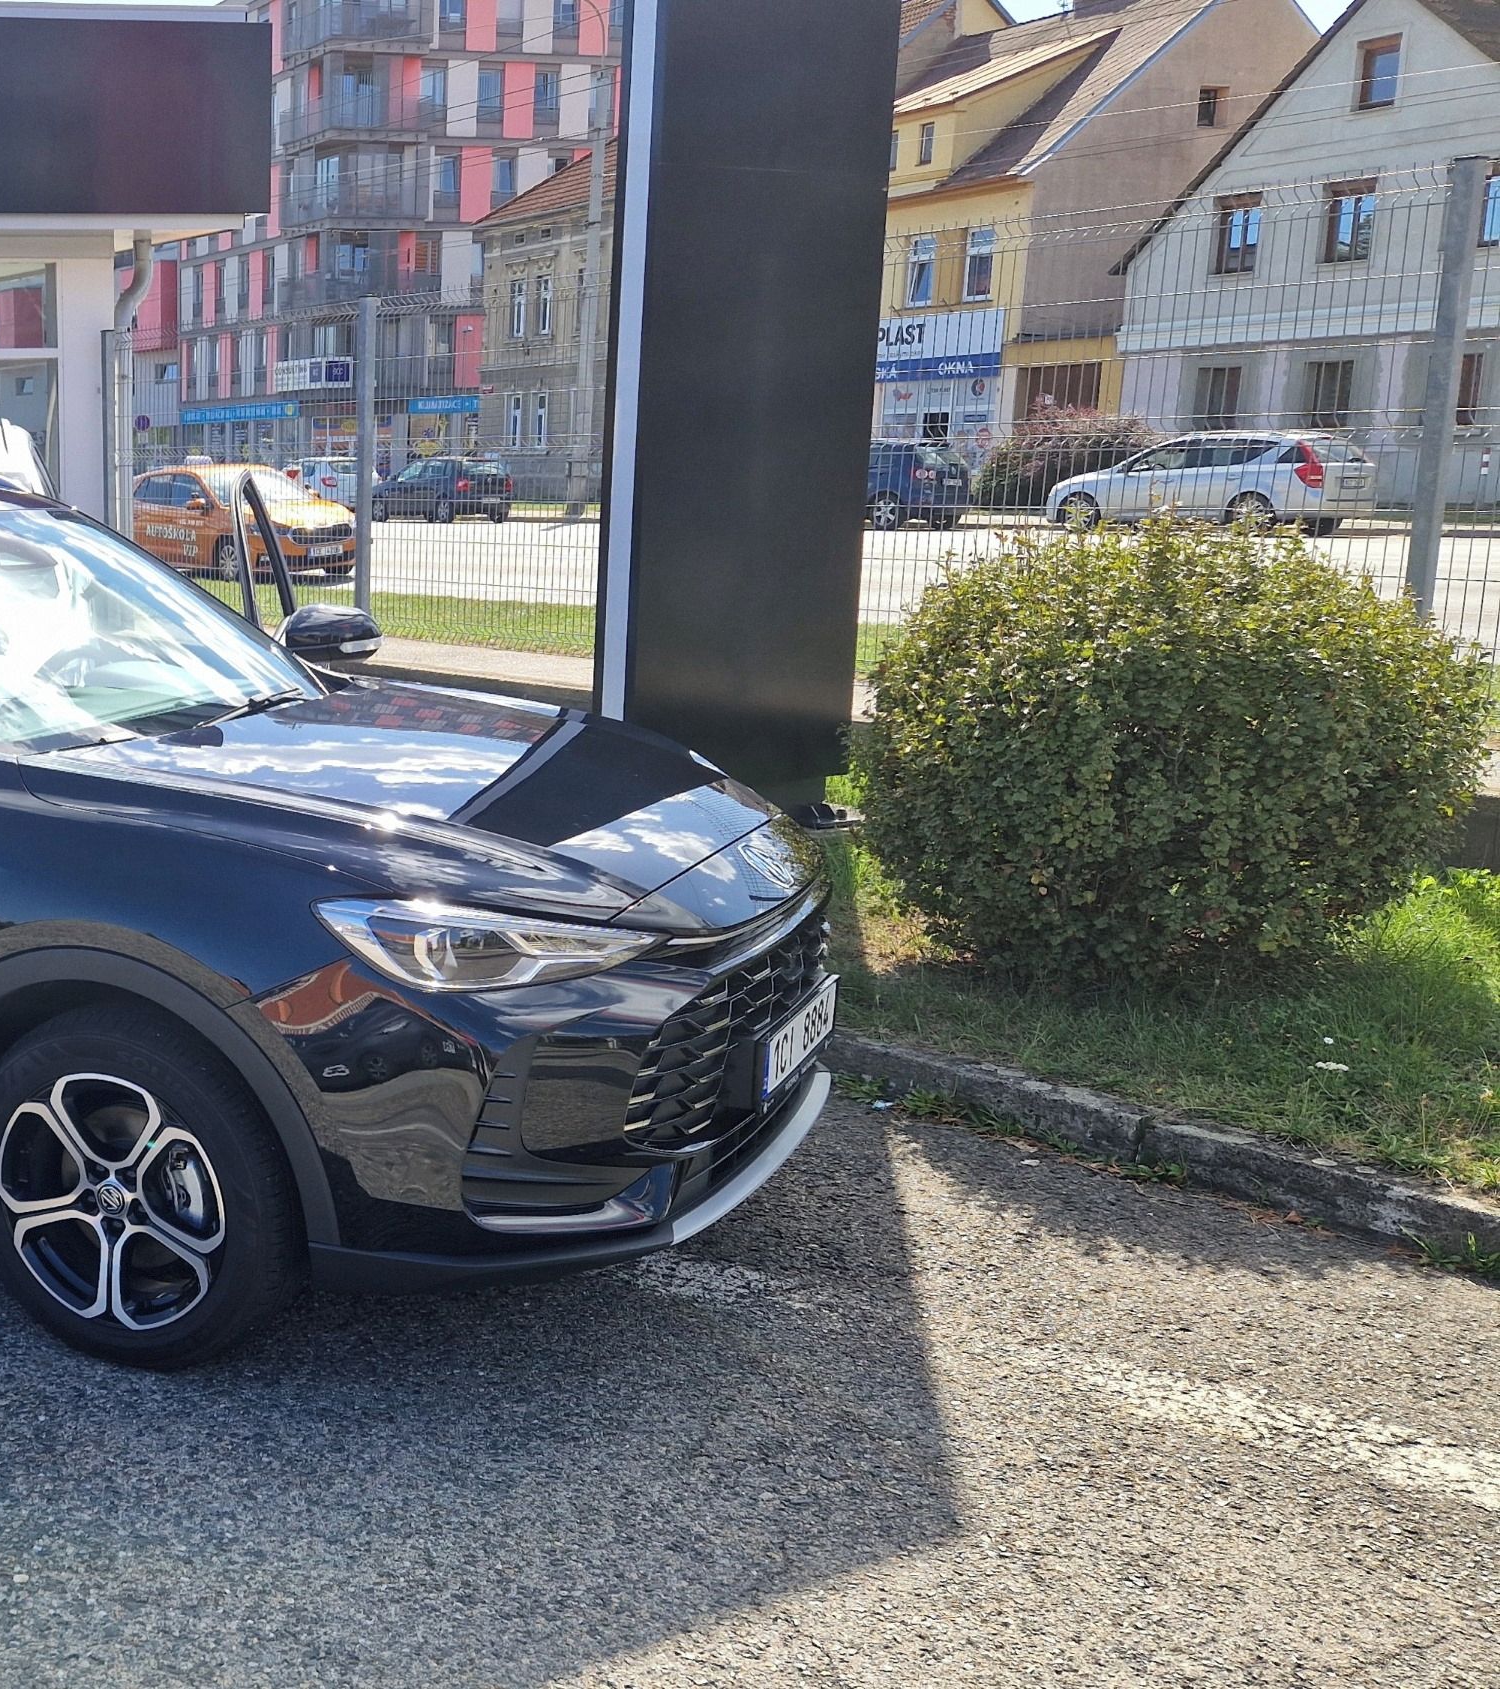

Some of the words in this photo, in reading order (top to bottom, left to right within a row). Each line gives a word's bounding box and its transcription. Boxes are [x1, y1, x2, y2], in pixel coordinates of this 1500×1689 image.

[938, 361, 974, 376] OKNA
[146, 524, 197, 541] AUTOŠKOLA
[183, 544, 199, 556] VIP
[803, 992, 830, 1051] 8884
